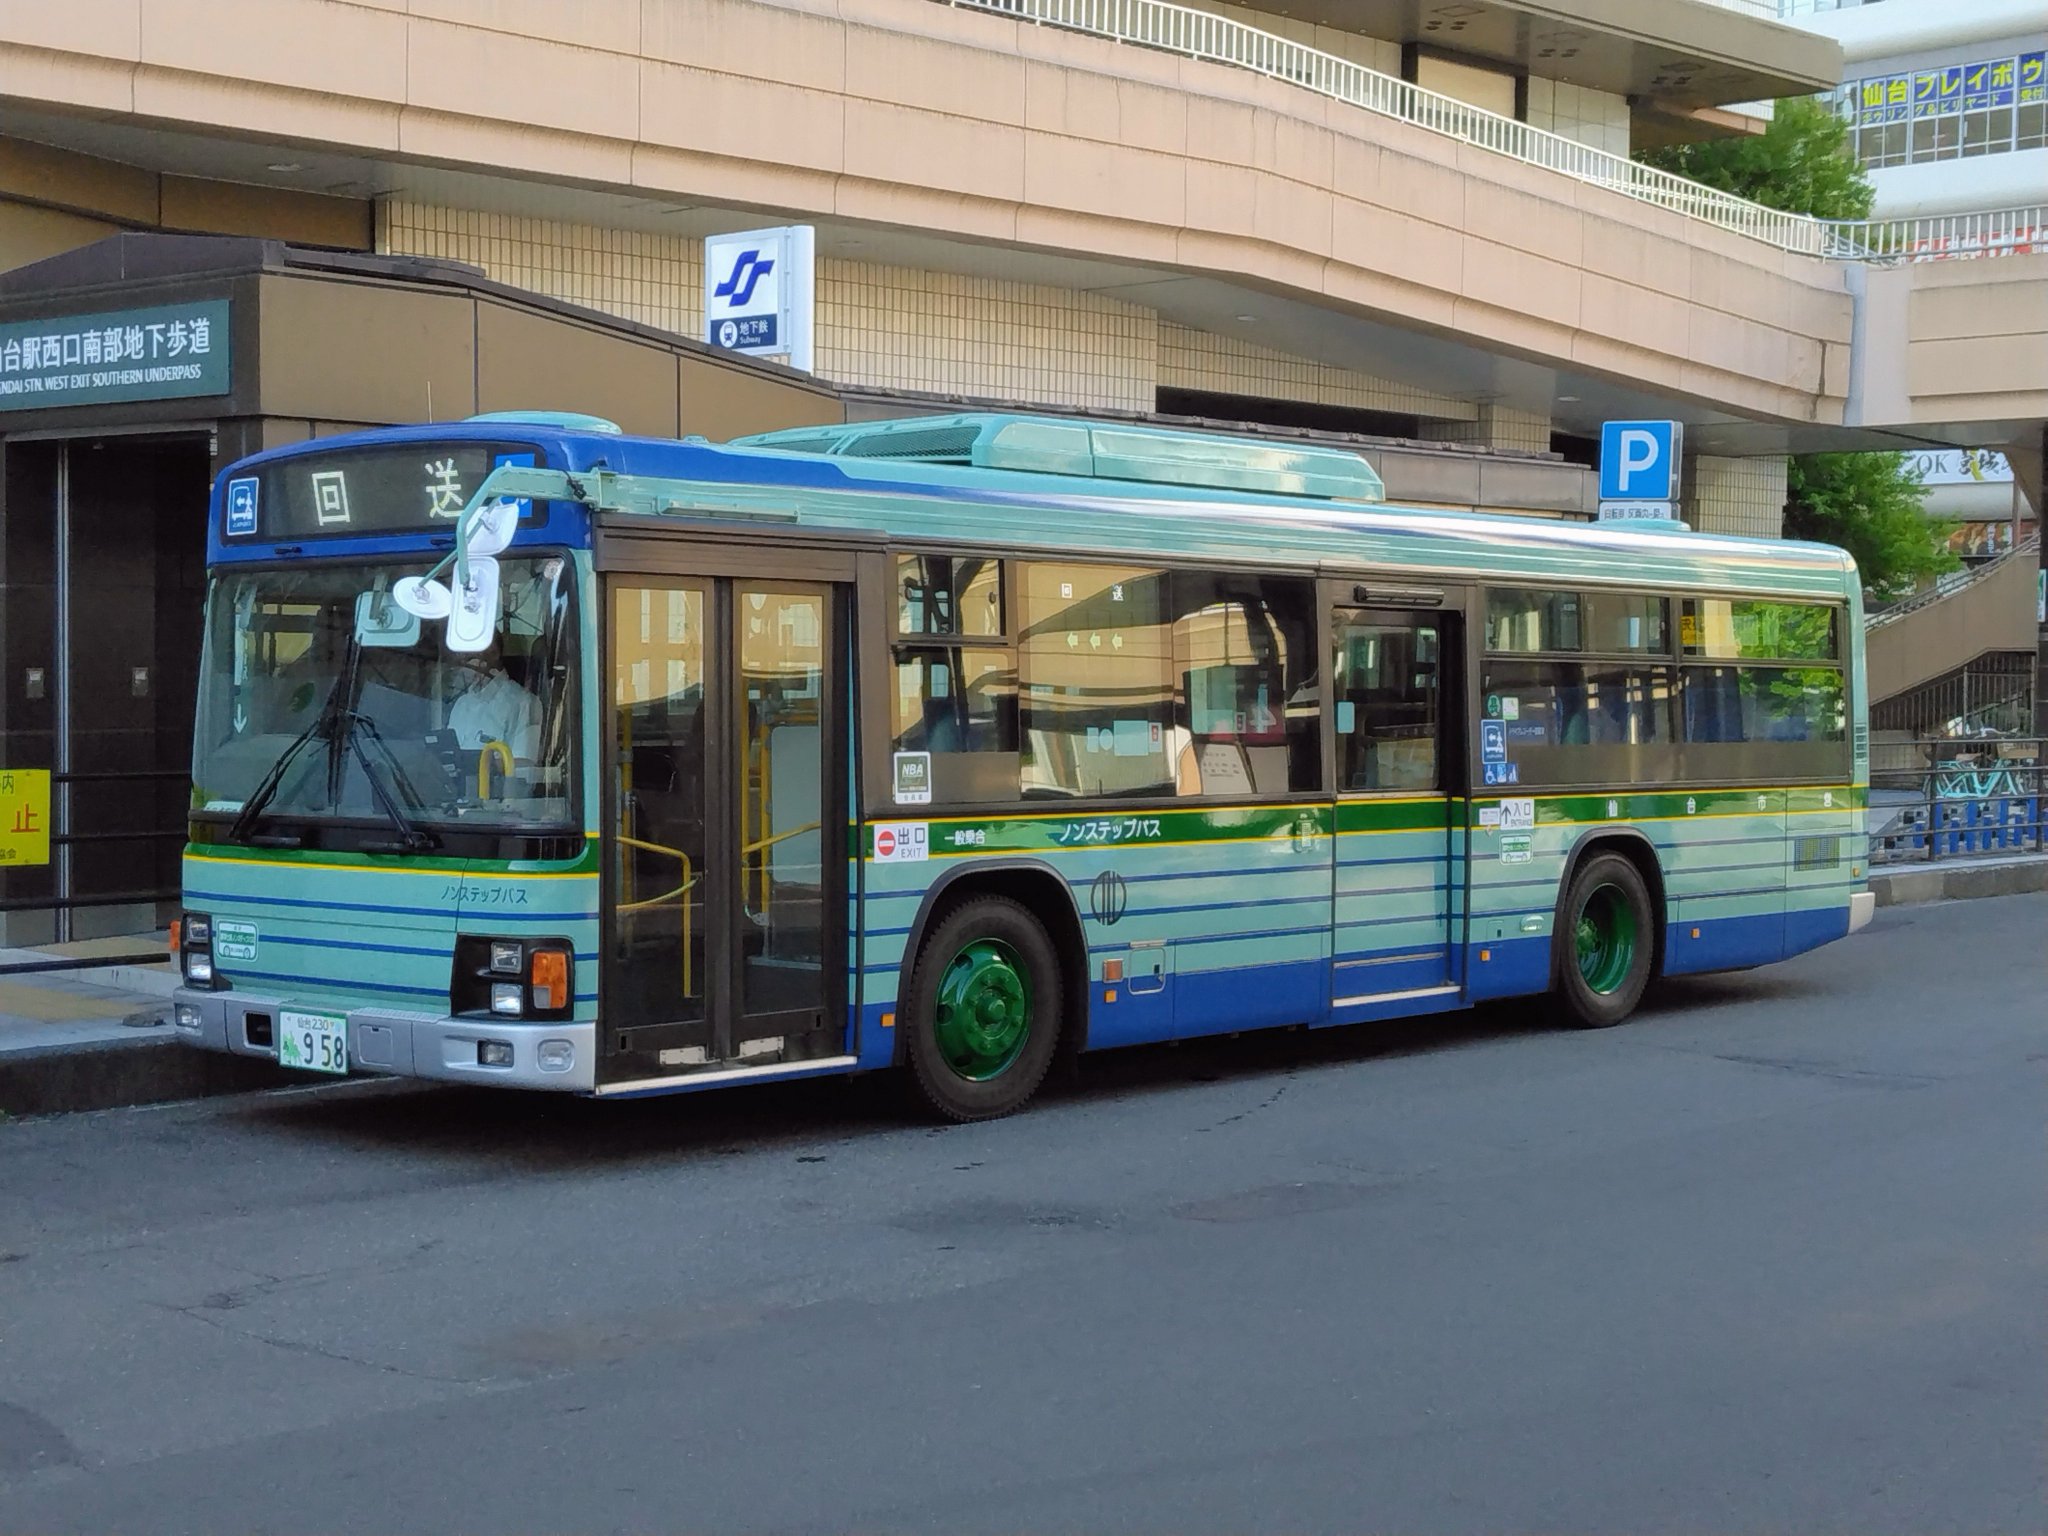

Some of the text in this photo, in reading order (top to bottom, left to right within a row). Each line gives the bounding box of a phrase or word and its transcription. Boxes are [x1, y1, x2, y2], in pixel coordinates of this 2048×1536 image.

[740, 320, 768, 335] 地下鉄
[0, 317, 210, 372] 台駅西口南部地下歩道
[740, 336, 761, 345] Subway
[0, 379, 23, 395] NDAI
[46, 375, 69, 390] WEST
[71, 373, 91, 389] EXIT
[93, 369, 143, 387] SOUTHERN
[145, 364, 201, 382] UNDERPASS
[1619, 430, 1659, 491] P
[902, 763, 923, 777] NBA
[11, 803, 40, 833] 止
[1514, 802, 1531, 817] 入口
[898, 827, 926, 845] 出口
[944, 829, 986, 846] 一般乗合
[1060, 818, 1161, 842] ノンステップバス
[901, 848, 922, 858] EXIT
[441, 885, 528, 904] ノンステップバス
